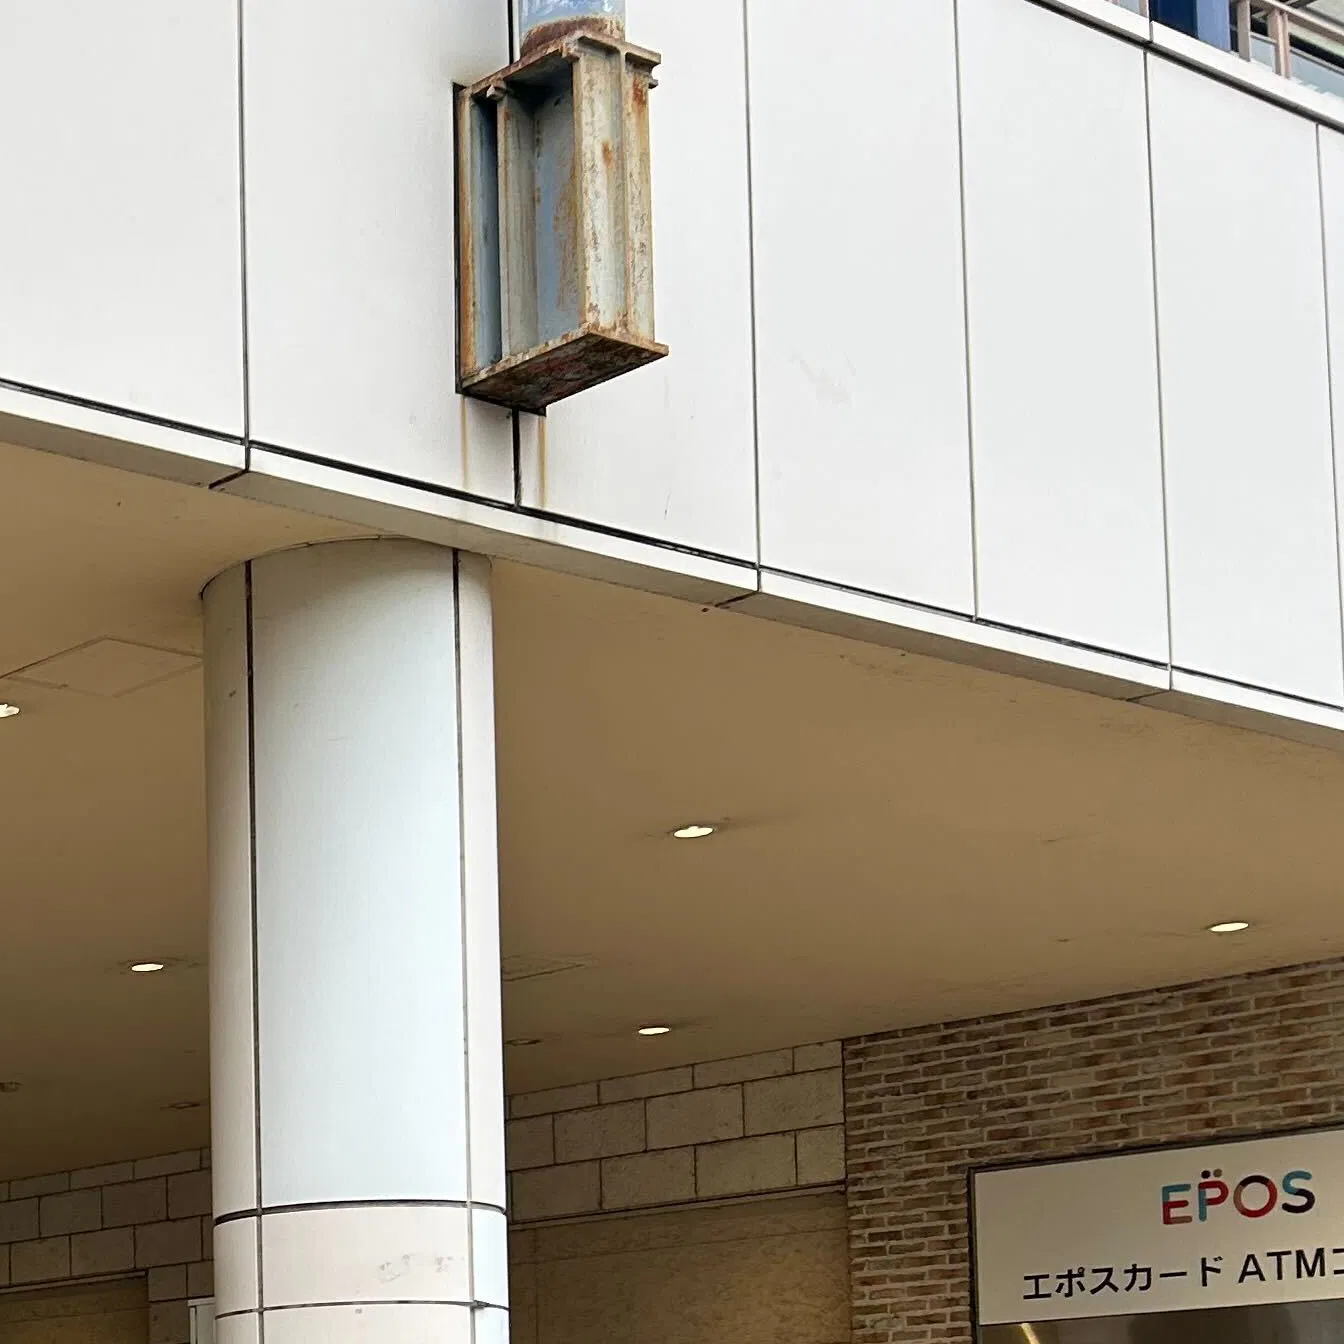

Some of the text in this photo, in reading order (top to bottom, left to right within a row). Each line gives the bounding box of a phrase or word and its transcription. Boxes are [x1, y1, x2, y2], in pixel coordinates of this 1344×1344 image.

[1022, 1255, 1224, 1301] エポスカード
